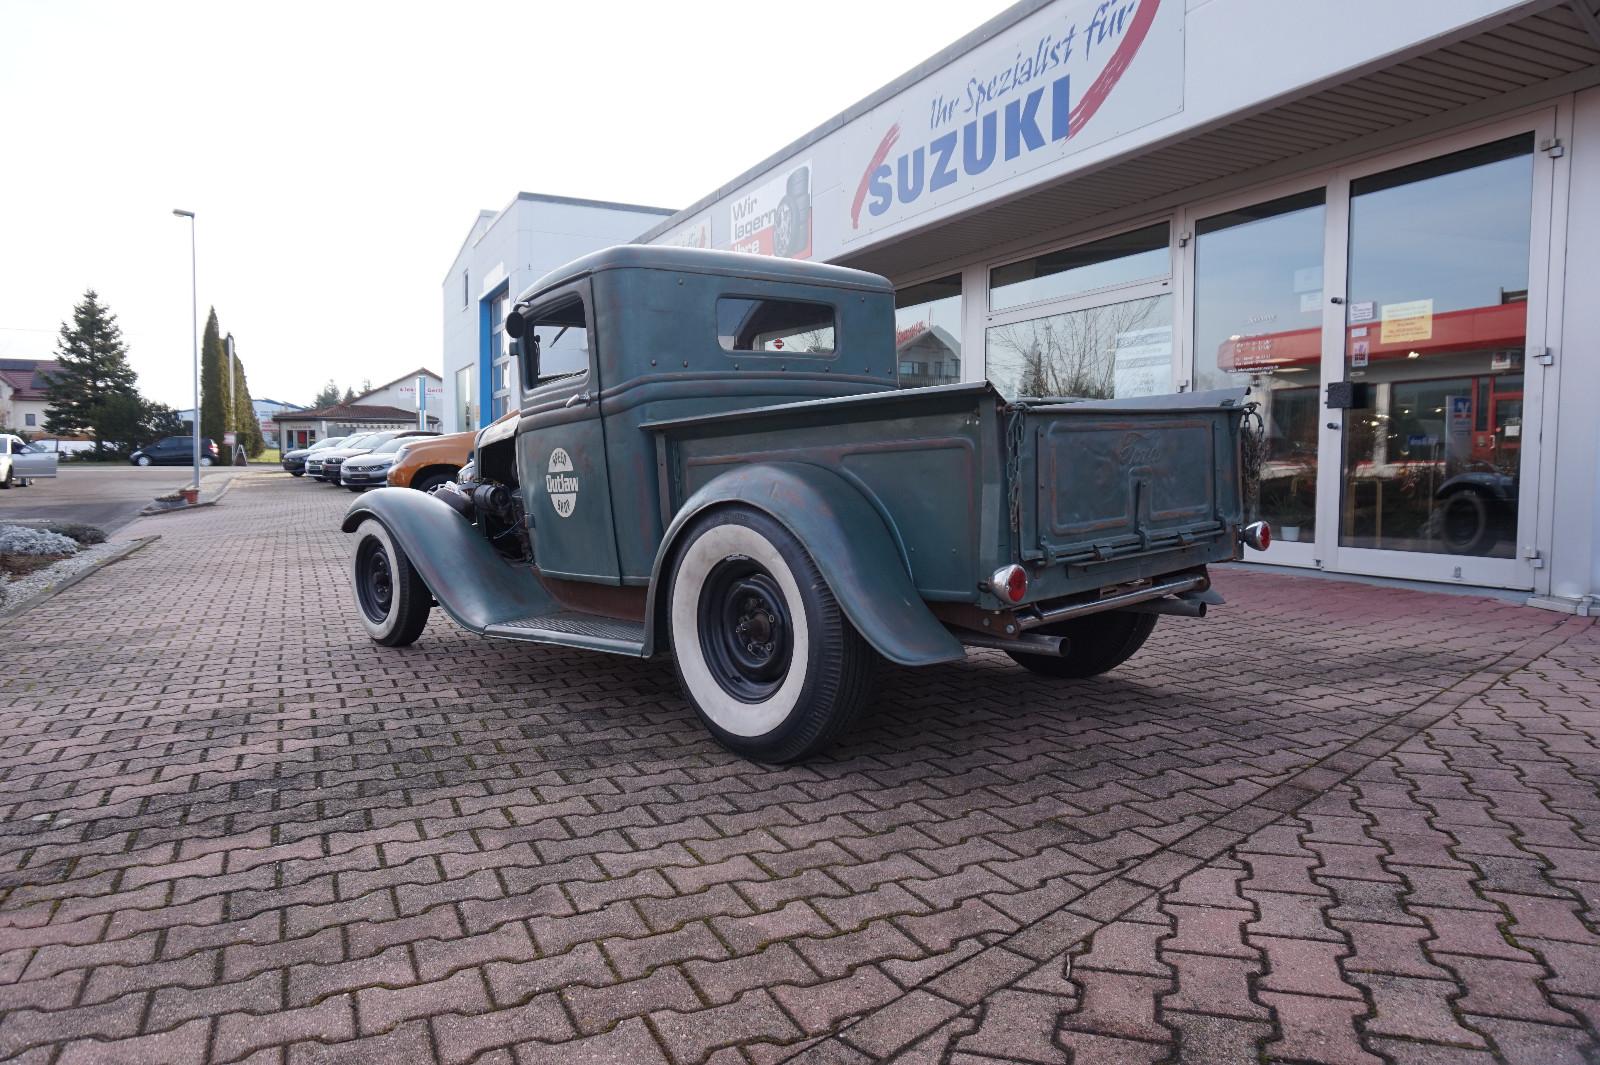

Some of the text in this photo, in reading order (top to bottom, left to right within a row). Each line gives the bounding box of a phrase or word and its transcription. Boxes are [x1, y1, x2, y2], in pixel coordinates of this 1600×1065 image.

[930, 0, 1134, 129] Ihr Spezialist für
[869, 73, 1070, 217] SUZUKI
[733, 197, 758, 221] Wir
[735, 209, 777, 239] lagern
[546, 474, 579, 492] Outlaw
